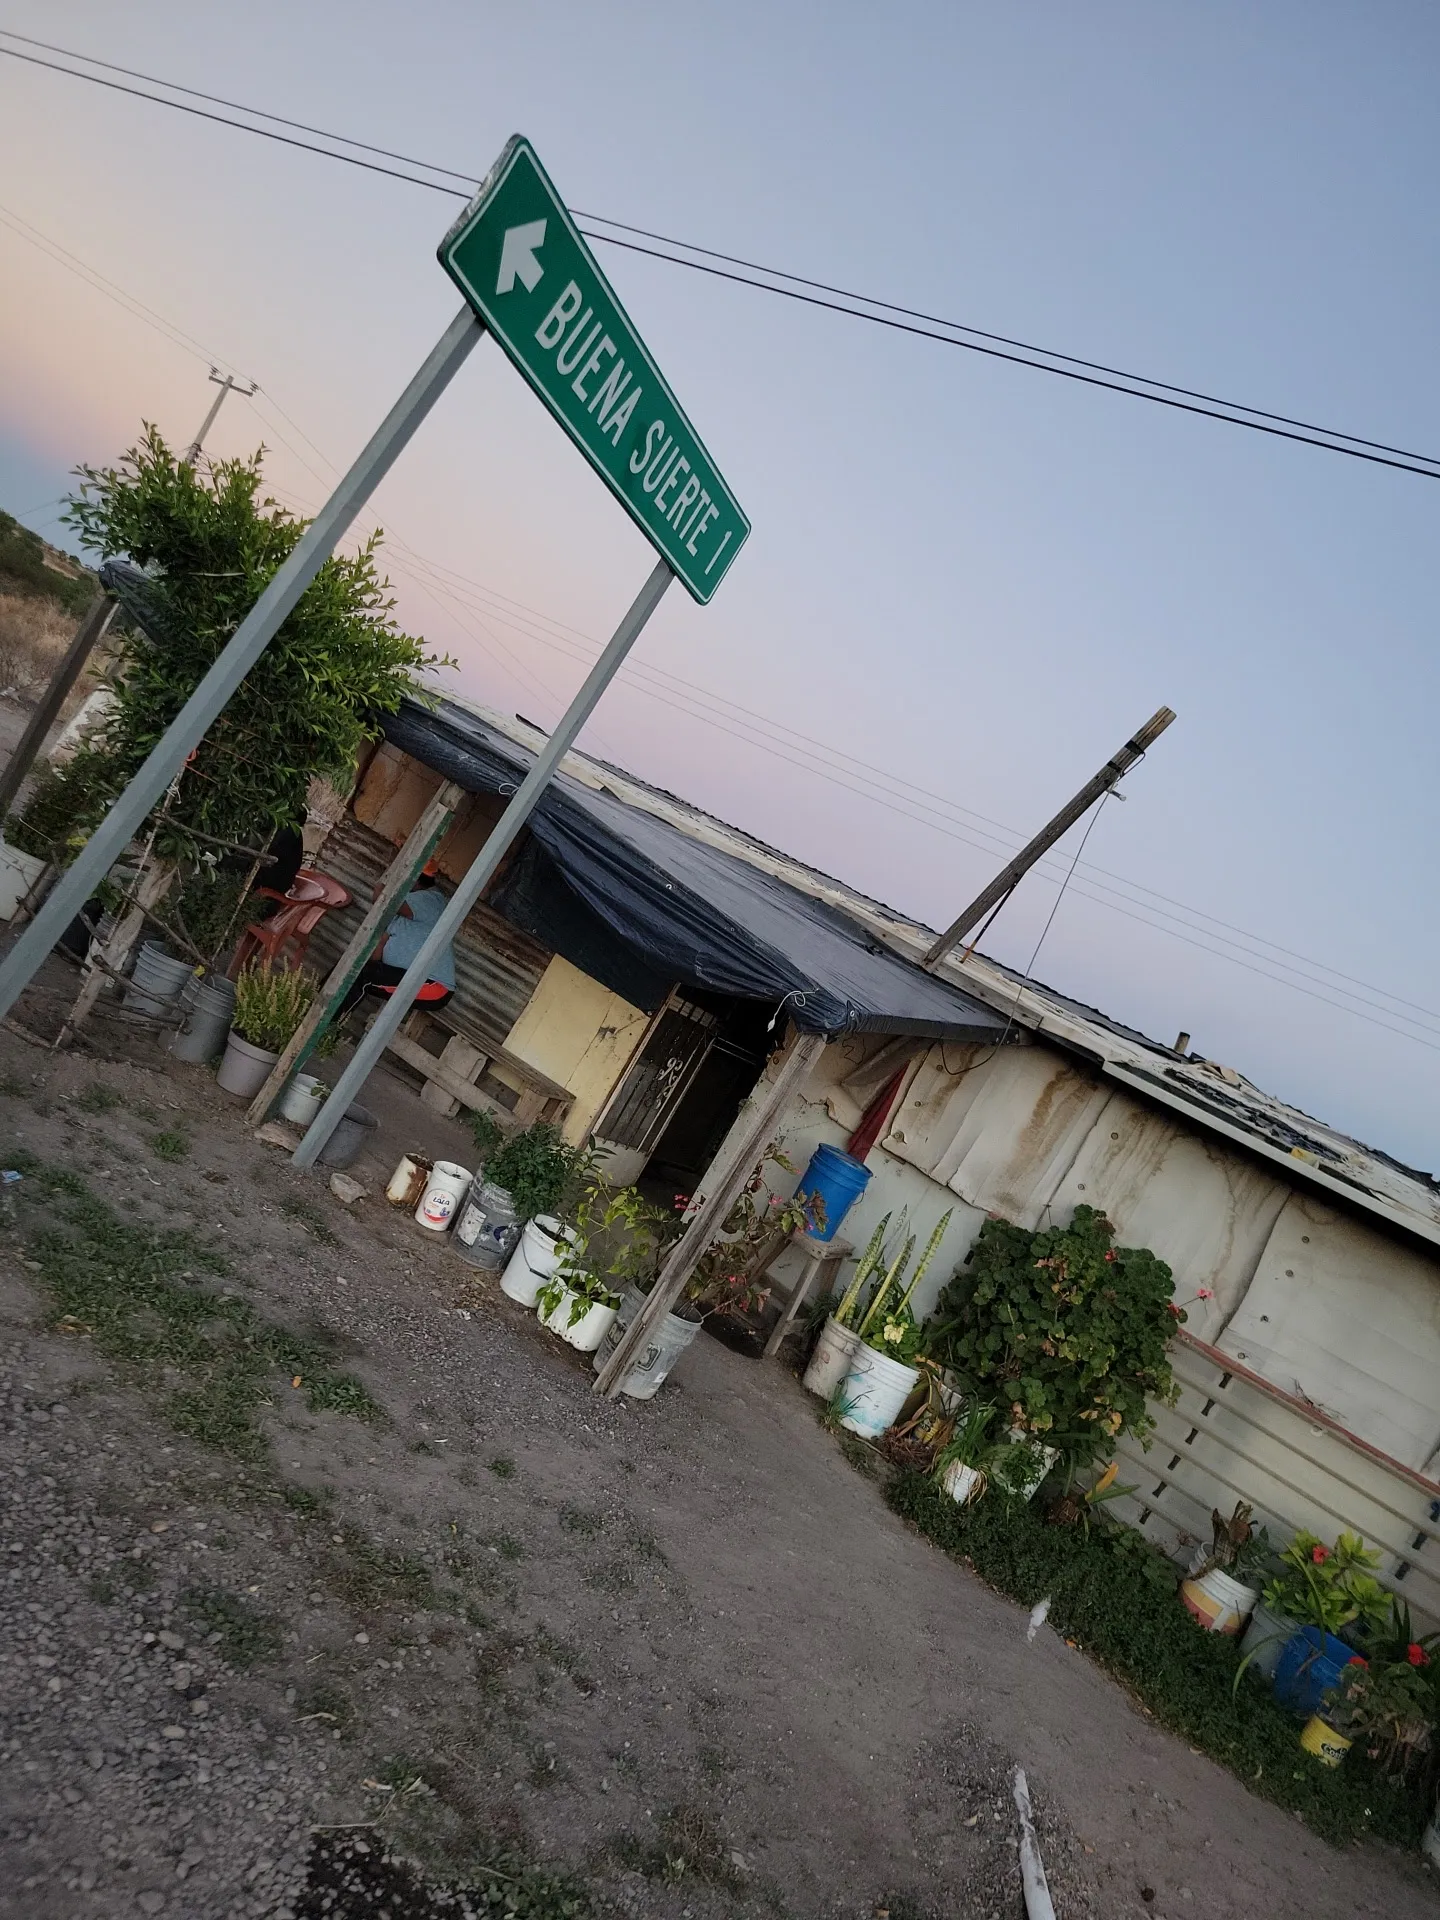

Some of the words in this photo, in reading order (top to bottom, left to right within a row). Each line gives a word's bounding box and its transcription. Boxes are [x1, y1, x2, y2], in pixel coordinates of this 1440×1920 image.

[534, 280, 643, 447] BUENA
[629, 420, 719, 556] SUERTE
[704, 531, 732, 575] 1
